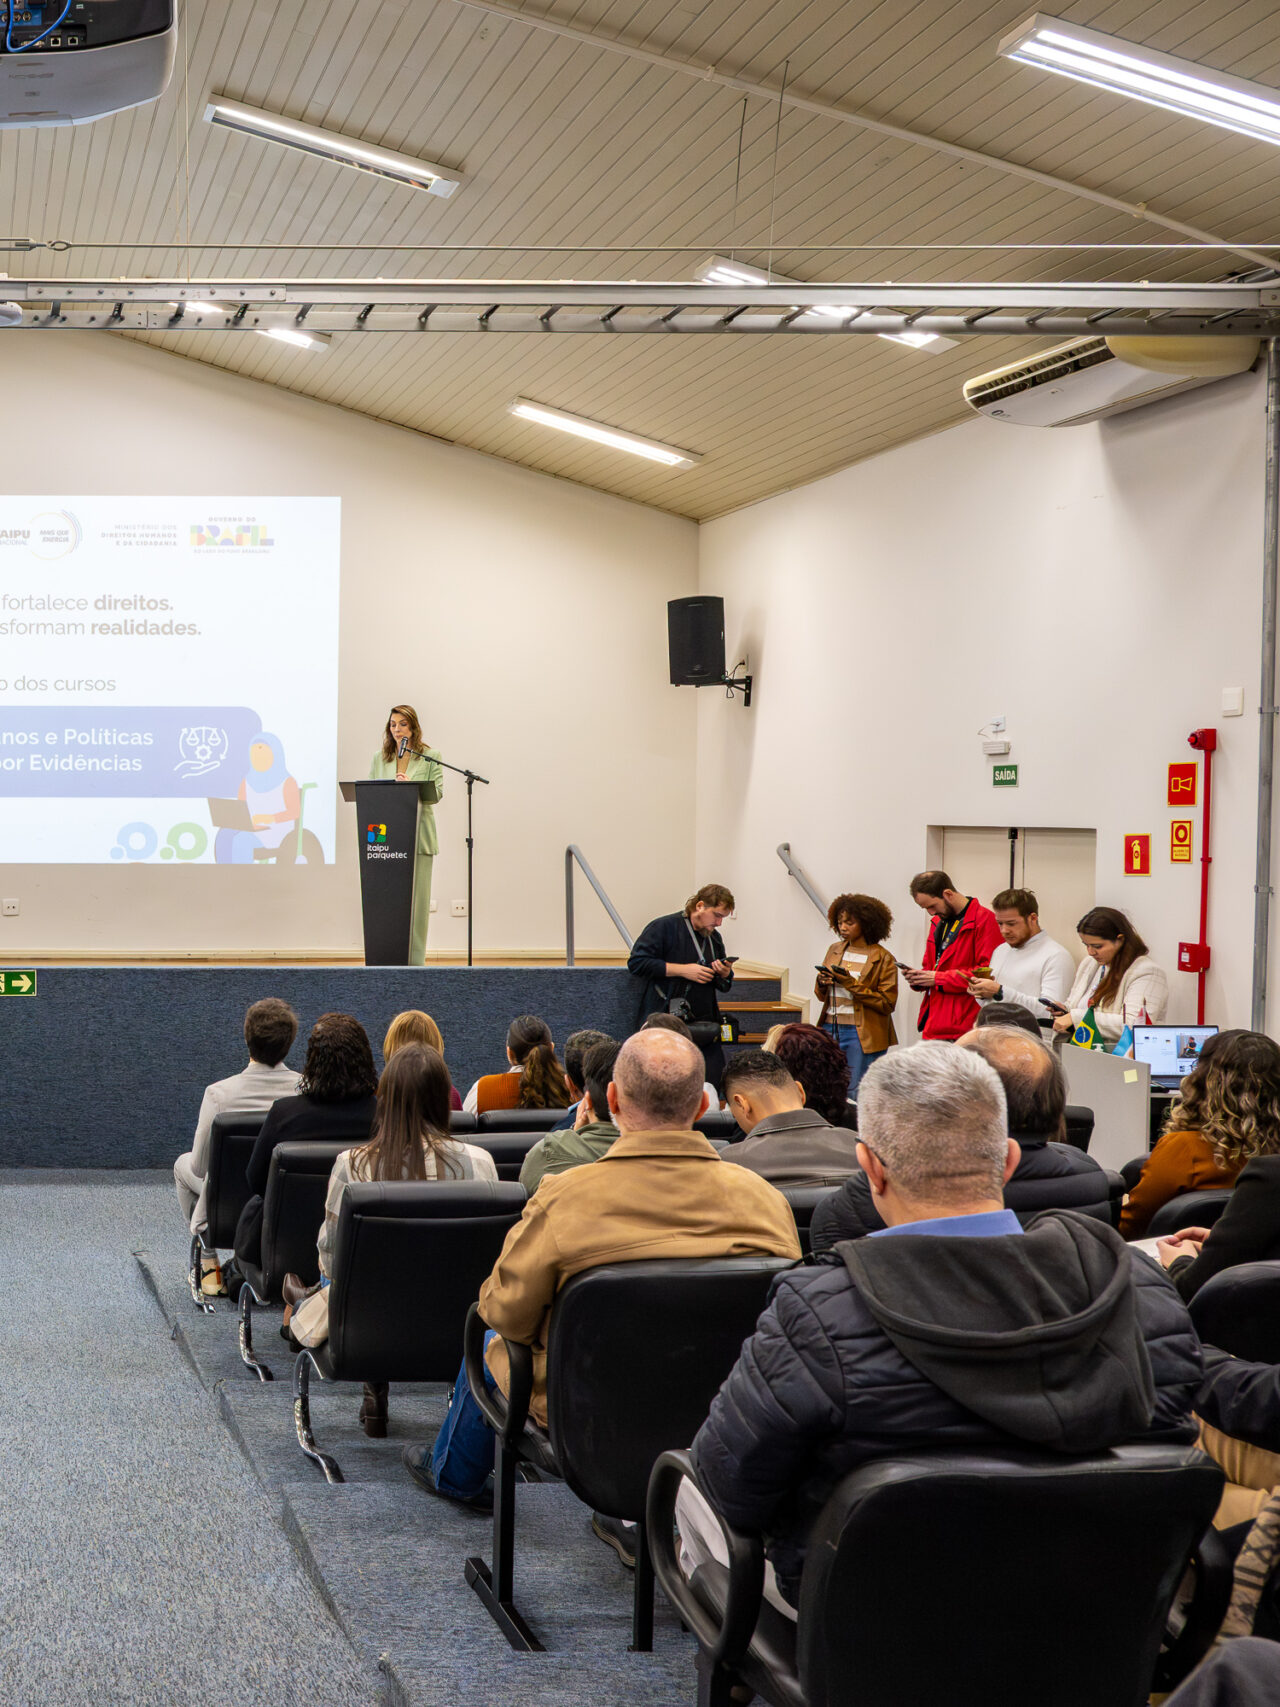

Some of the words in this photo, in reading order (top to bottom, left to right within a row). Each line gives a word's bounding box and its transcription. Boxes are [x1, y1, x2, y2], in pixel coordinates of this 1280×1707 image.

[190, 525, 275, 546] BRASIL
[1, 593, 89, 611] fortalece
[94, 593, 174, 611] direitos.
[90, 618, 202, 636] realidades.
[13, 674, 49, 692] dos
[53, 679, 117, 692] cursos
[44, 731, 58, 745] e
[64, 727, 154, 746] Políticas
[29, 752, 143, 772] Evidências
[994, 767, 1016, 781] SAÍDA
[367, 844, 389, 852] itaipu
[367, 851, 408, 860] parquetec
